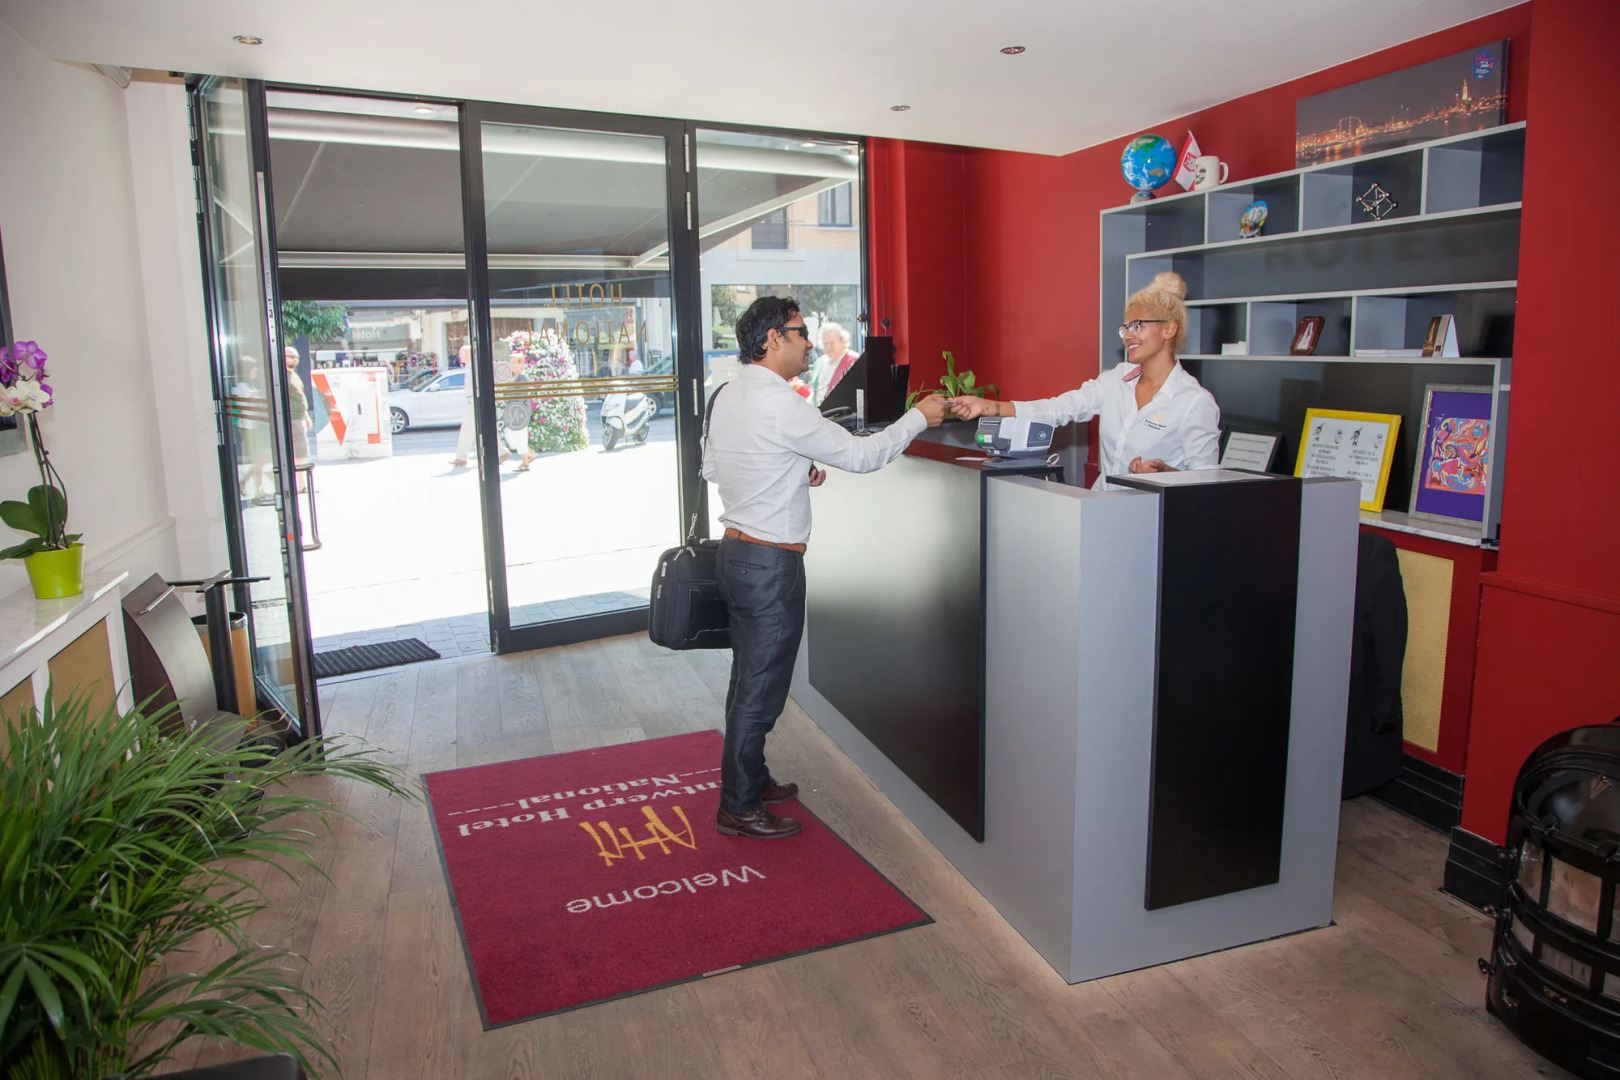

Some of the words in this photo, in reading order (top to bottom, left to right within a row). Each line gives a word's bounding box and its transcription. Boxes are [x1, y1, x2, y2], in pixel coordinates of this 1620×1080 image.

[582, 779, 722, 811] ntwerp
[458, 807, 571, 836] Hotel
[565, 865, 766, 914] Welcome
